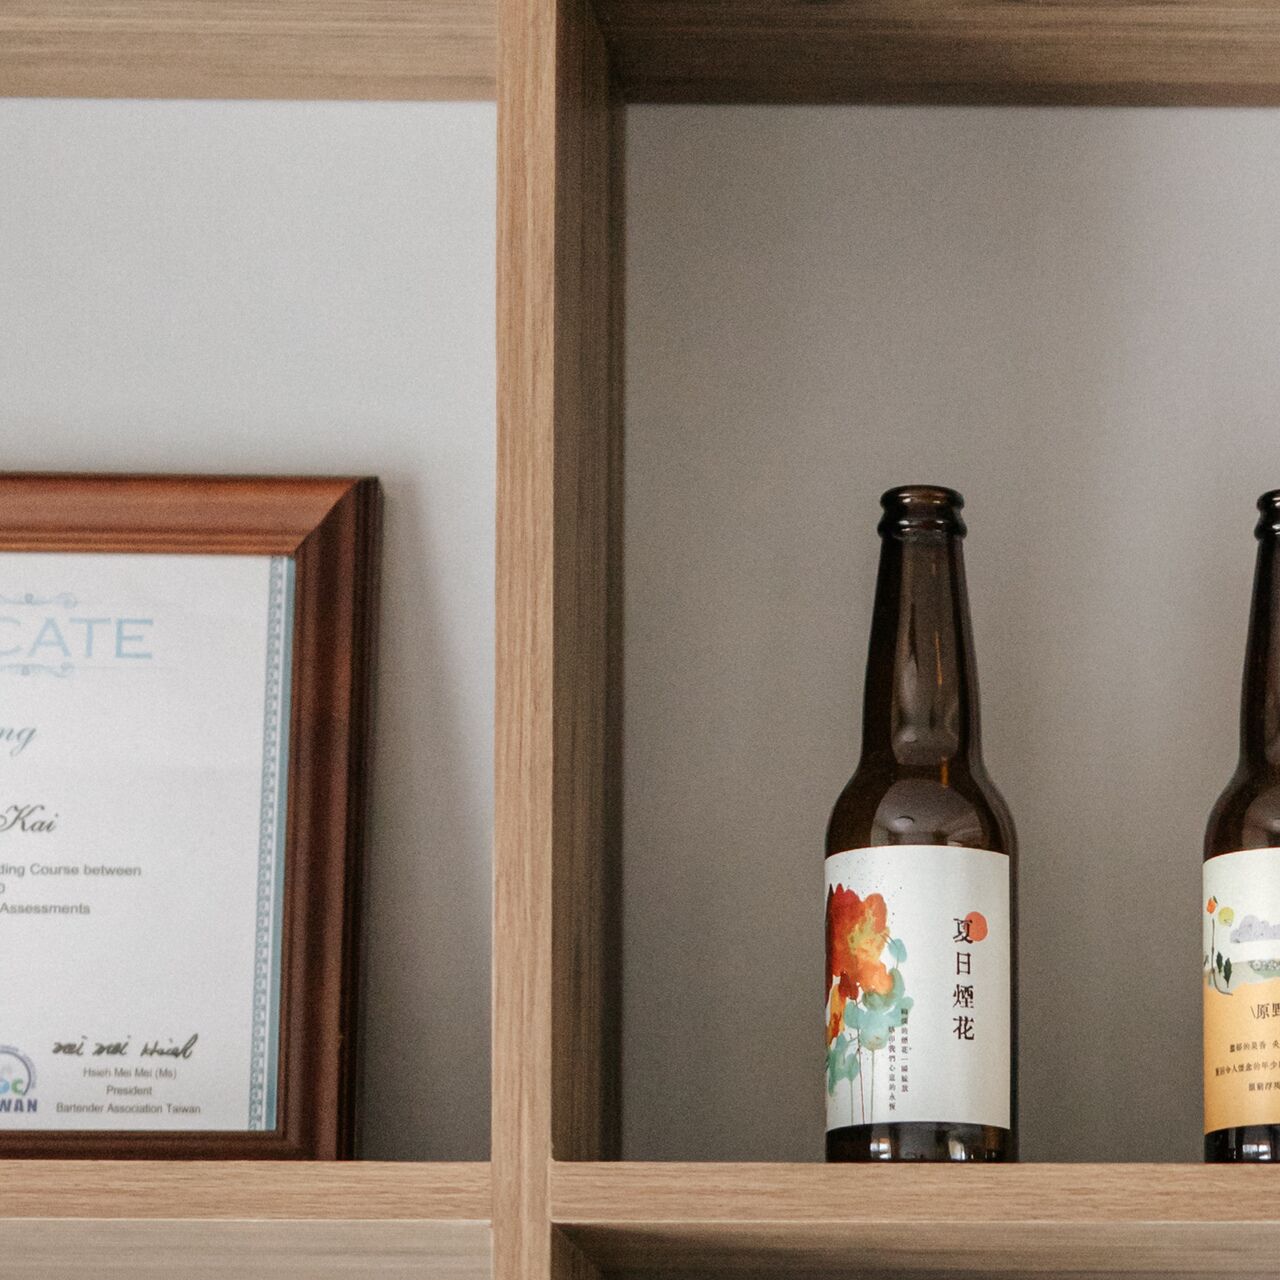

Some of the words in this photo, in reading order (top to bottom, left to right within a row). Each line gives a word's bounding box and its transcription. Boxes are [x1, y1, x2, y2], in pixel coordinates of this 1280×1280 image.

[30, 863, 79, 876] Course
[84, 864, 142, 876] between
[0, 902, 90, 915] Assessments
[106, 1085, 152, 1095] President
[56, 1102, 103, 1113] Bartender
[107, 1103, 163, 1113] Association
[167, 1103, 201, 1114] Taiwan
